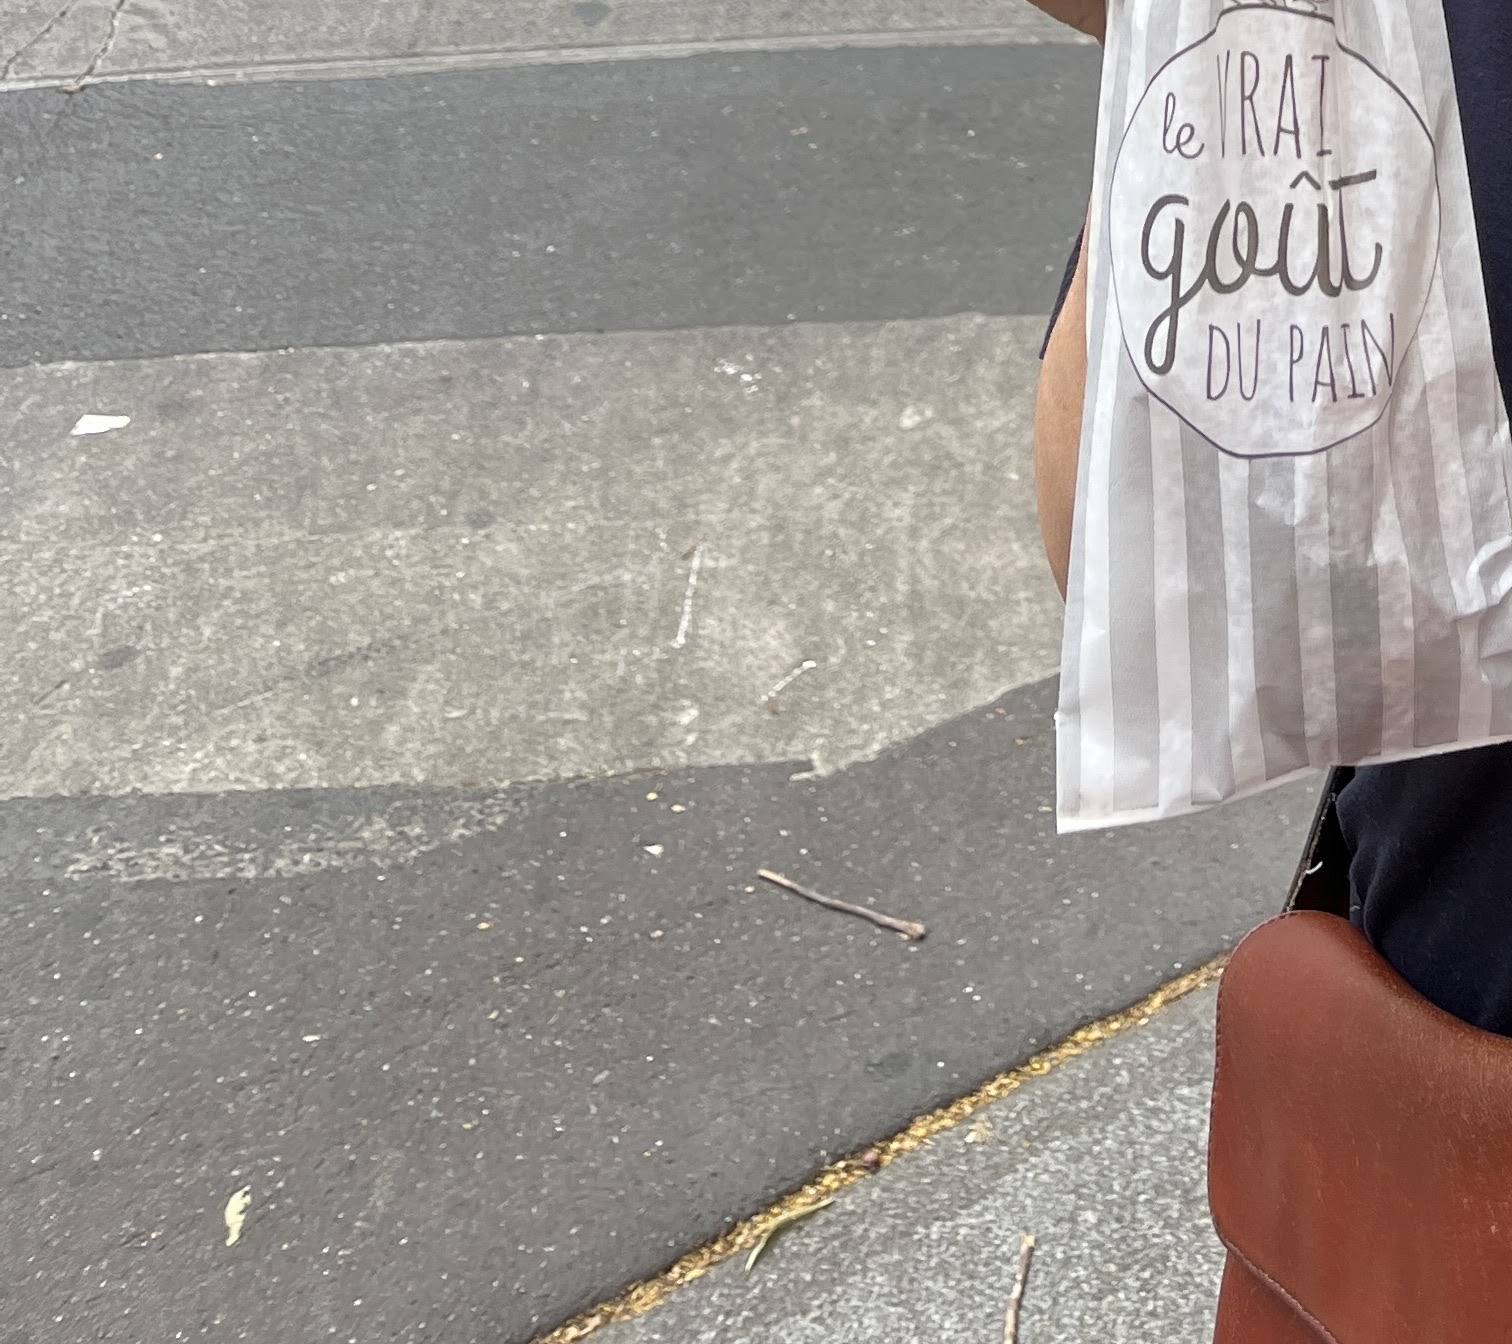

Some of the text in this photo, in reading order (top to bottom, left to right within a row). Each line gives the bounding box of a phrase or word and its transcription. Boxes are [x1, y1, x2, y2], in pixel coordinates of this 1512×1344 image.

[1162, 48, 1334, 160] le VRAI
[1140, 168, 1384, 376] goût
[1206, 312, 1396, 403] DU PAIN
